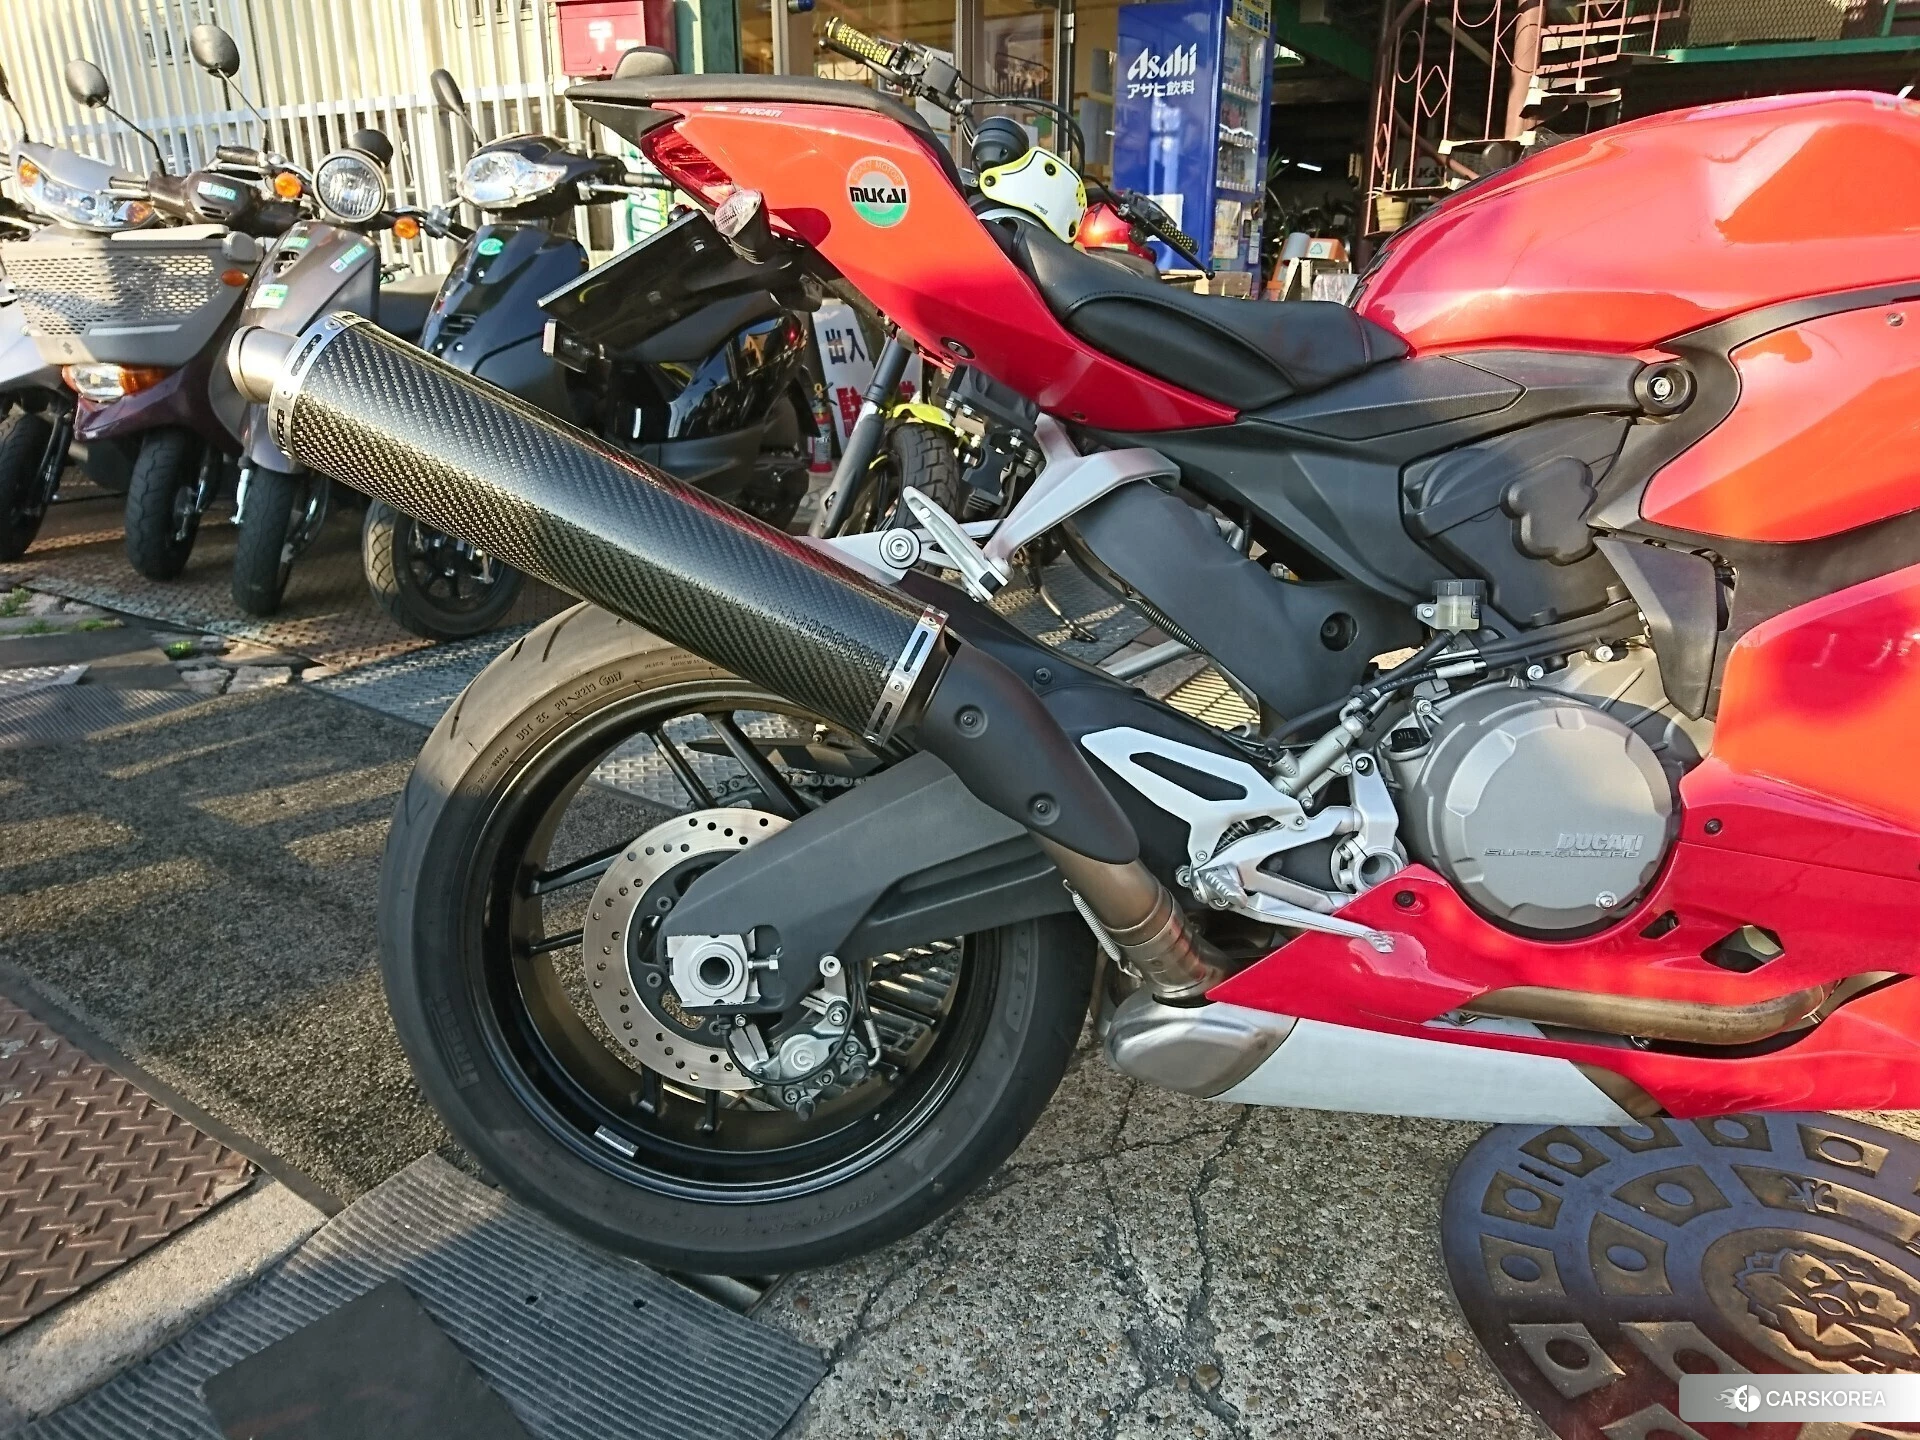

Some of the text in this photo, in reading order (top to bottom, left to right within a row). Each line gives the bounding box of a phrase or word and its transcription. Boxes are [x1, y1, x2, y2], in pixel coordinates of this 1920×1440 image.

[1127, 42, 1197, 80] Asahi
[1127, 80, 1195, 99] アサヒ飲料
[739, 107, 784, 118] DUCATI
[849, 187, 907, 203] MUKAI
[825, 328, 866, 365] 出入
[515, 723, 534, 741] DOT
[1556, 832, 1644, 850] DUCATI
